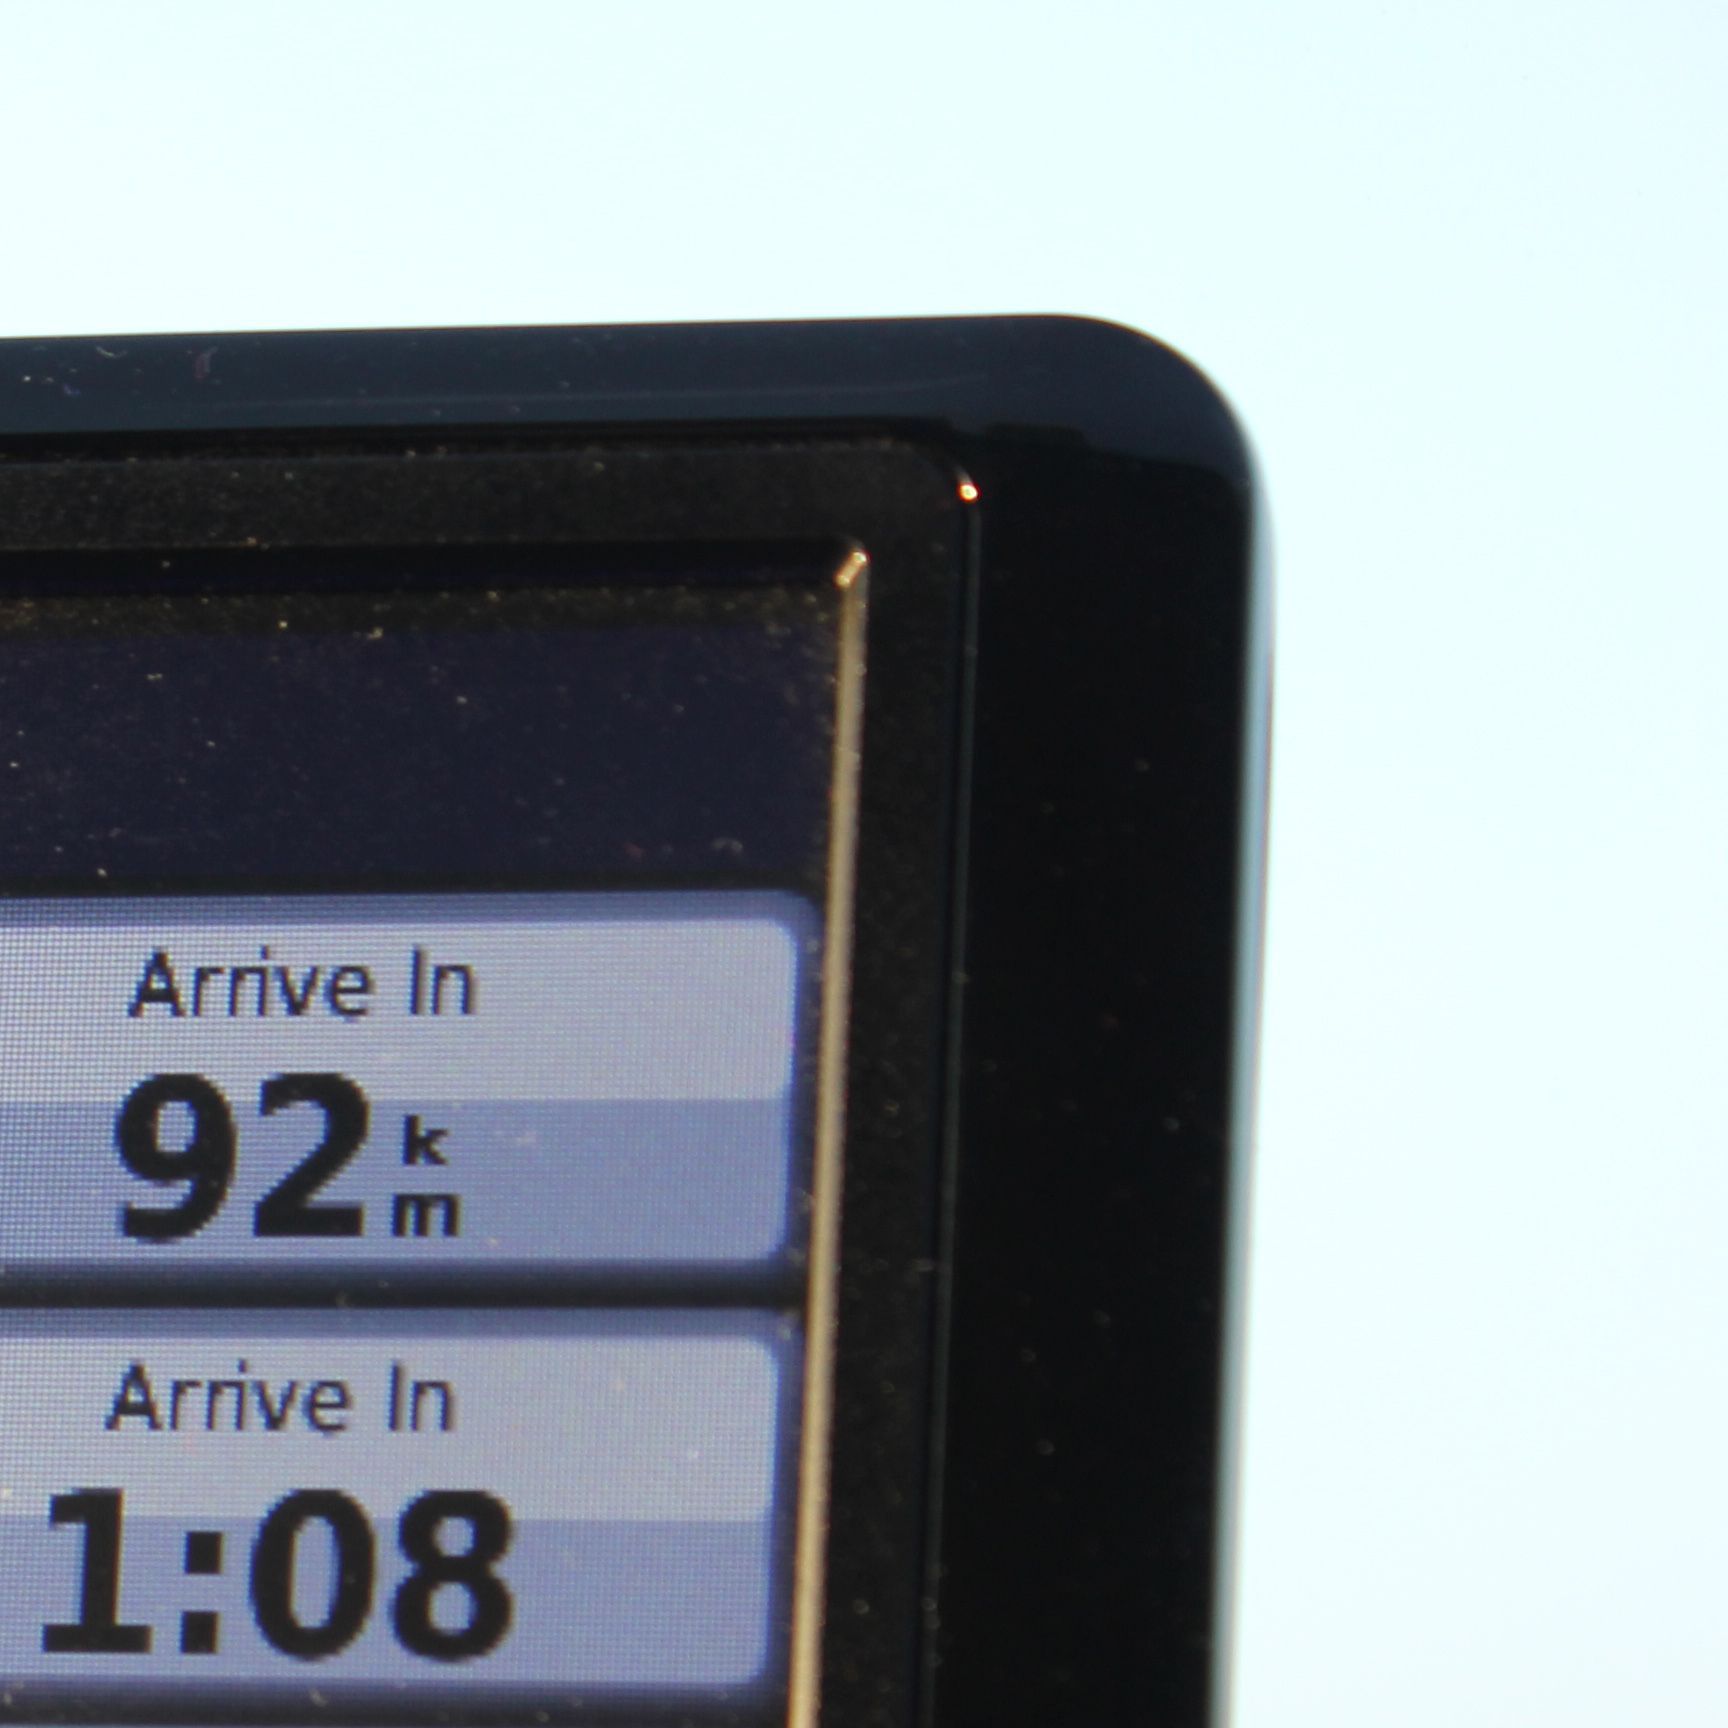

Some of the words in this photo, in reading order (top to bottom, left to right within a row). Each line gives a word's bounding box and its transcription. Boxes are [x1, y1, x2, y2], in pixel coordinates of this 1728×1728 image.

[127, 946, 373, 1022] Arrive
[409, 946, 476, 1018] In
[113, 1072, 372, 1243] 92
[106, 1360, 353, 1436] Arrive
[389, 1362, 456, 1432] In
[41, 1486, 515, 1662] 1:08
